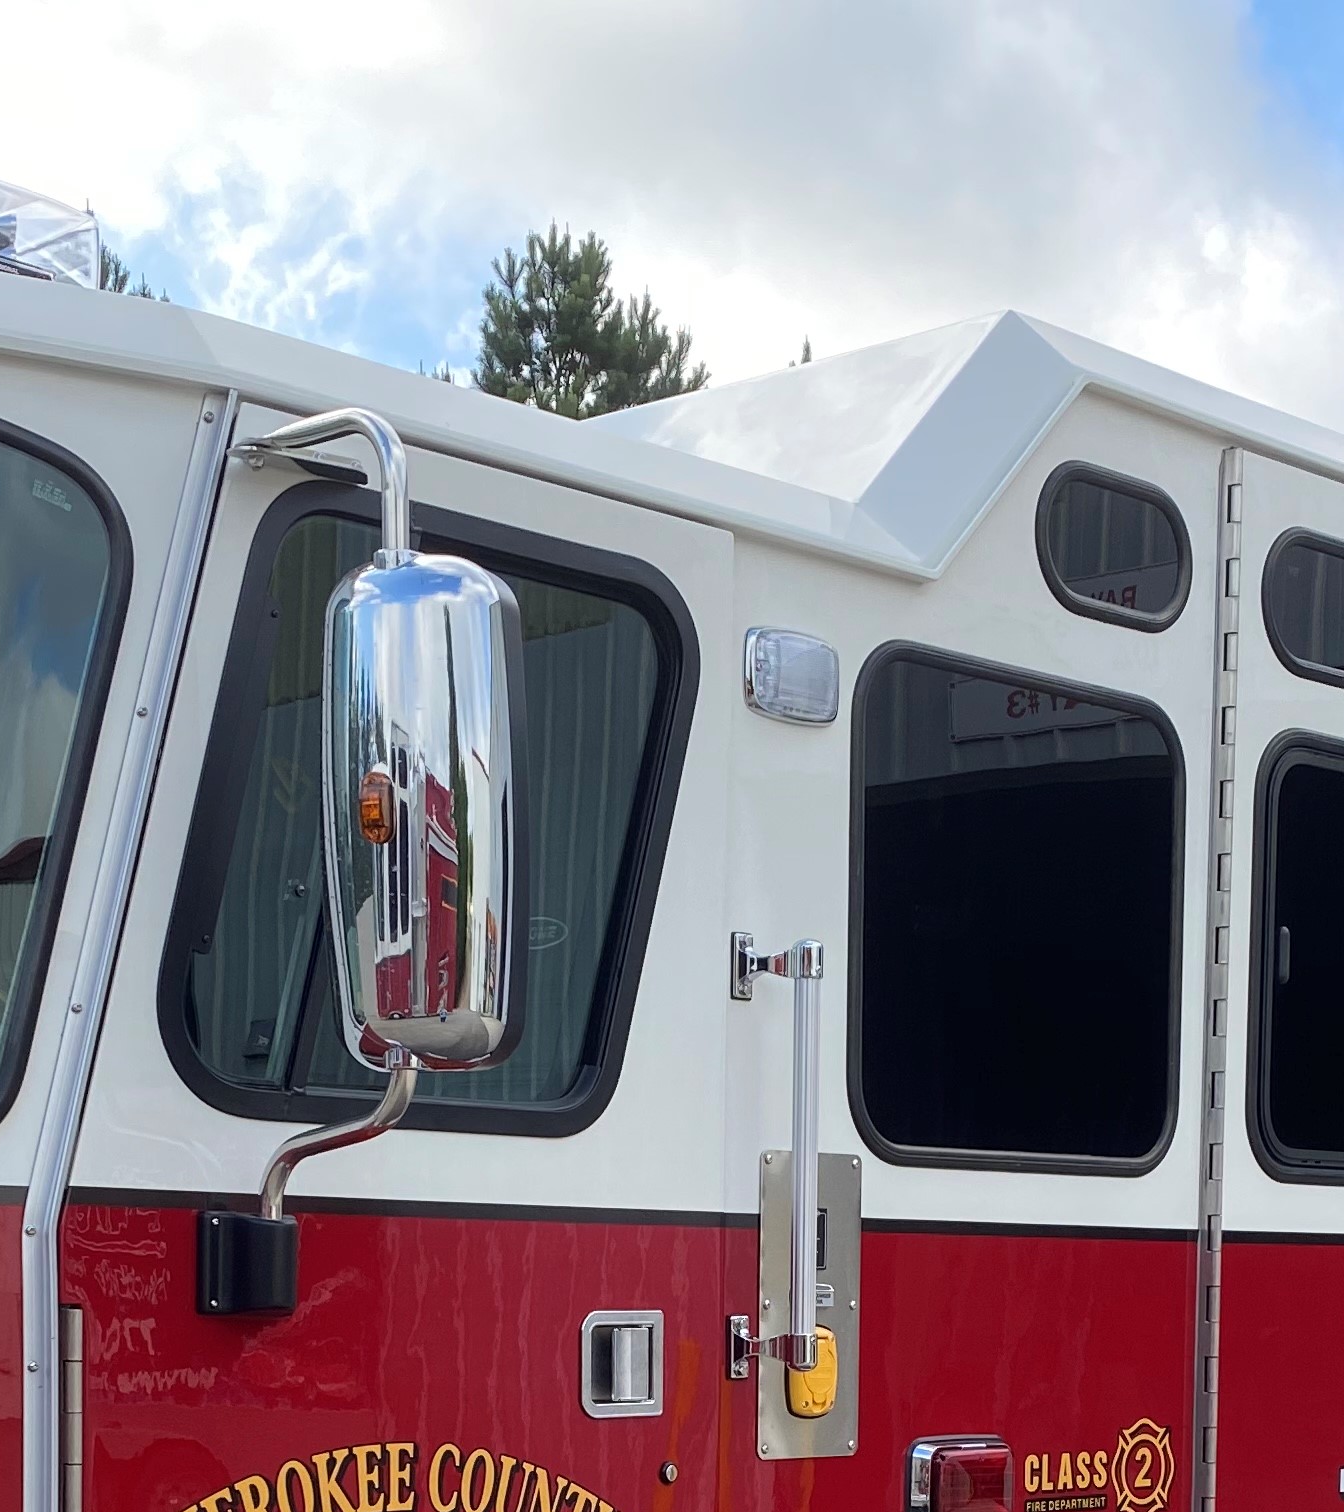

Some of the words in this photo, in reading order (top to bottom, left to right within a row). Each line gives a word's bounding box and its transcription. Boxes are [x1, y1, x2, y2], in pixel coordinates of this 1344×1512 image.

[1024, 1450, 1108, 1493] CLASS
[1134, 1447, 1153, 1487] 2
[1026, 1501, 1047, 1512] FIRE
[1048, 1497, 1106, 1511] DEPARTMENT
